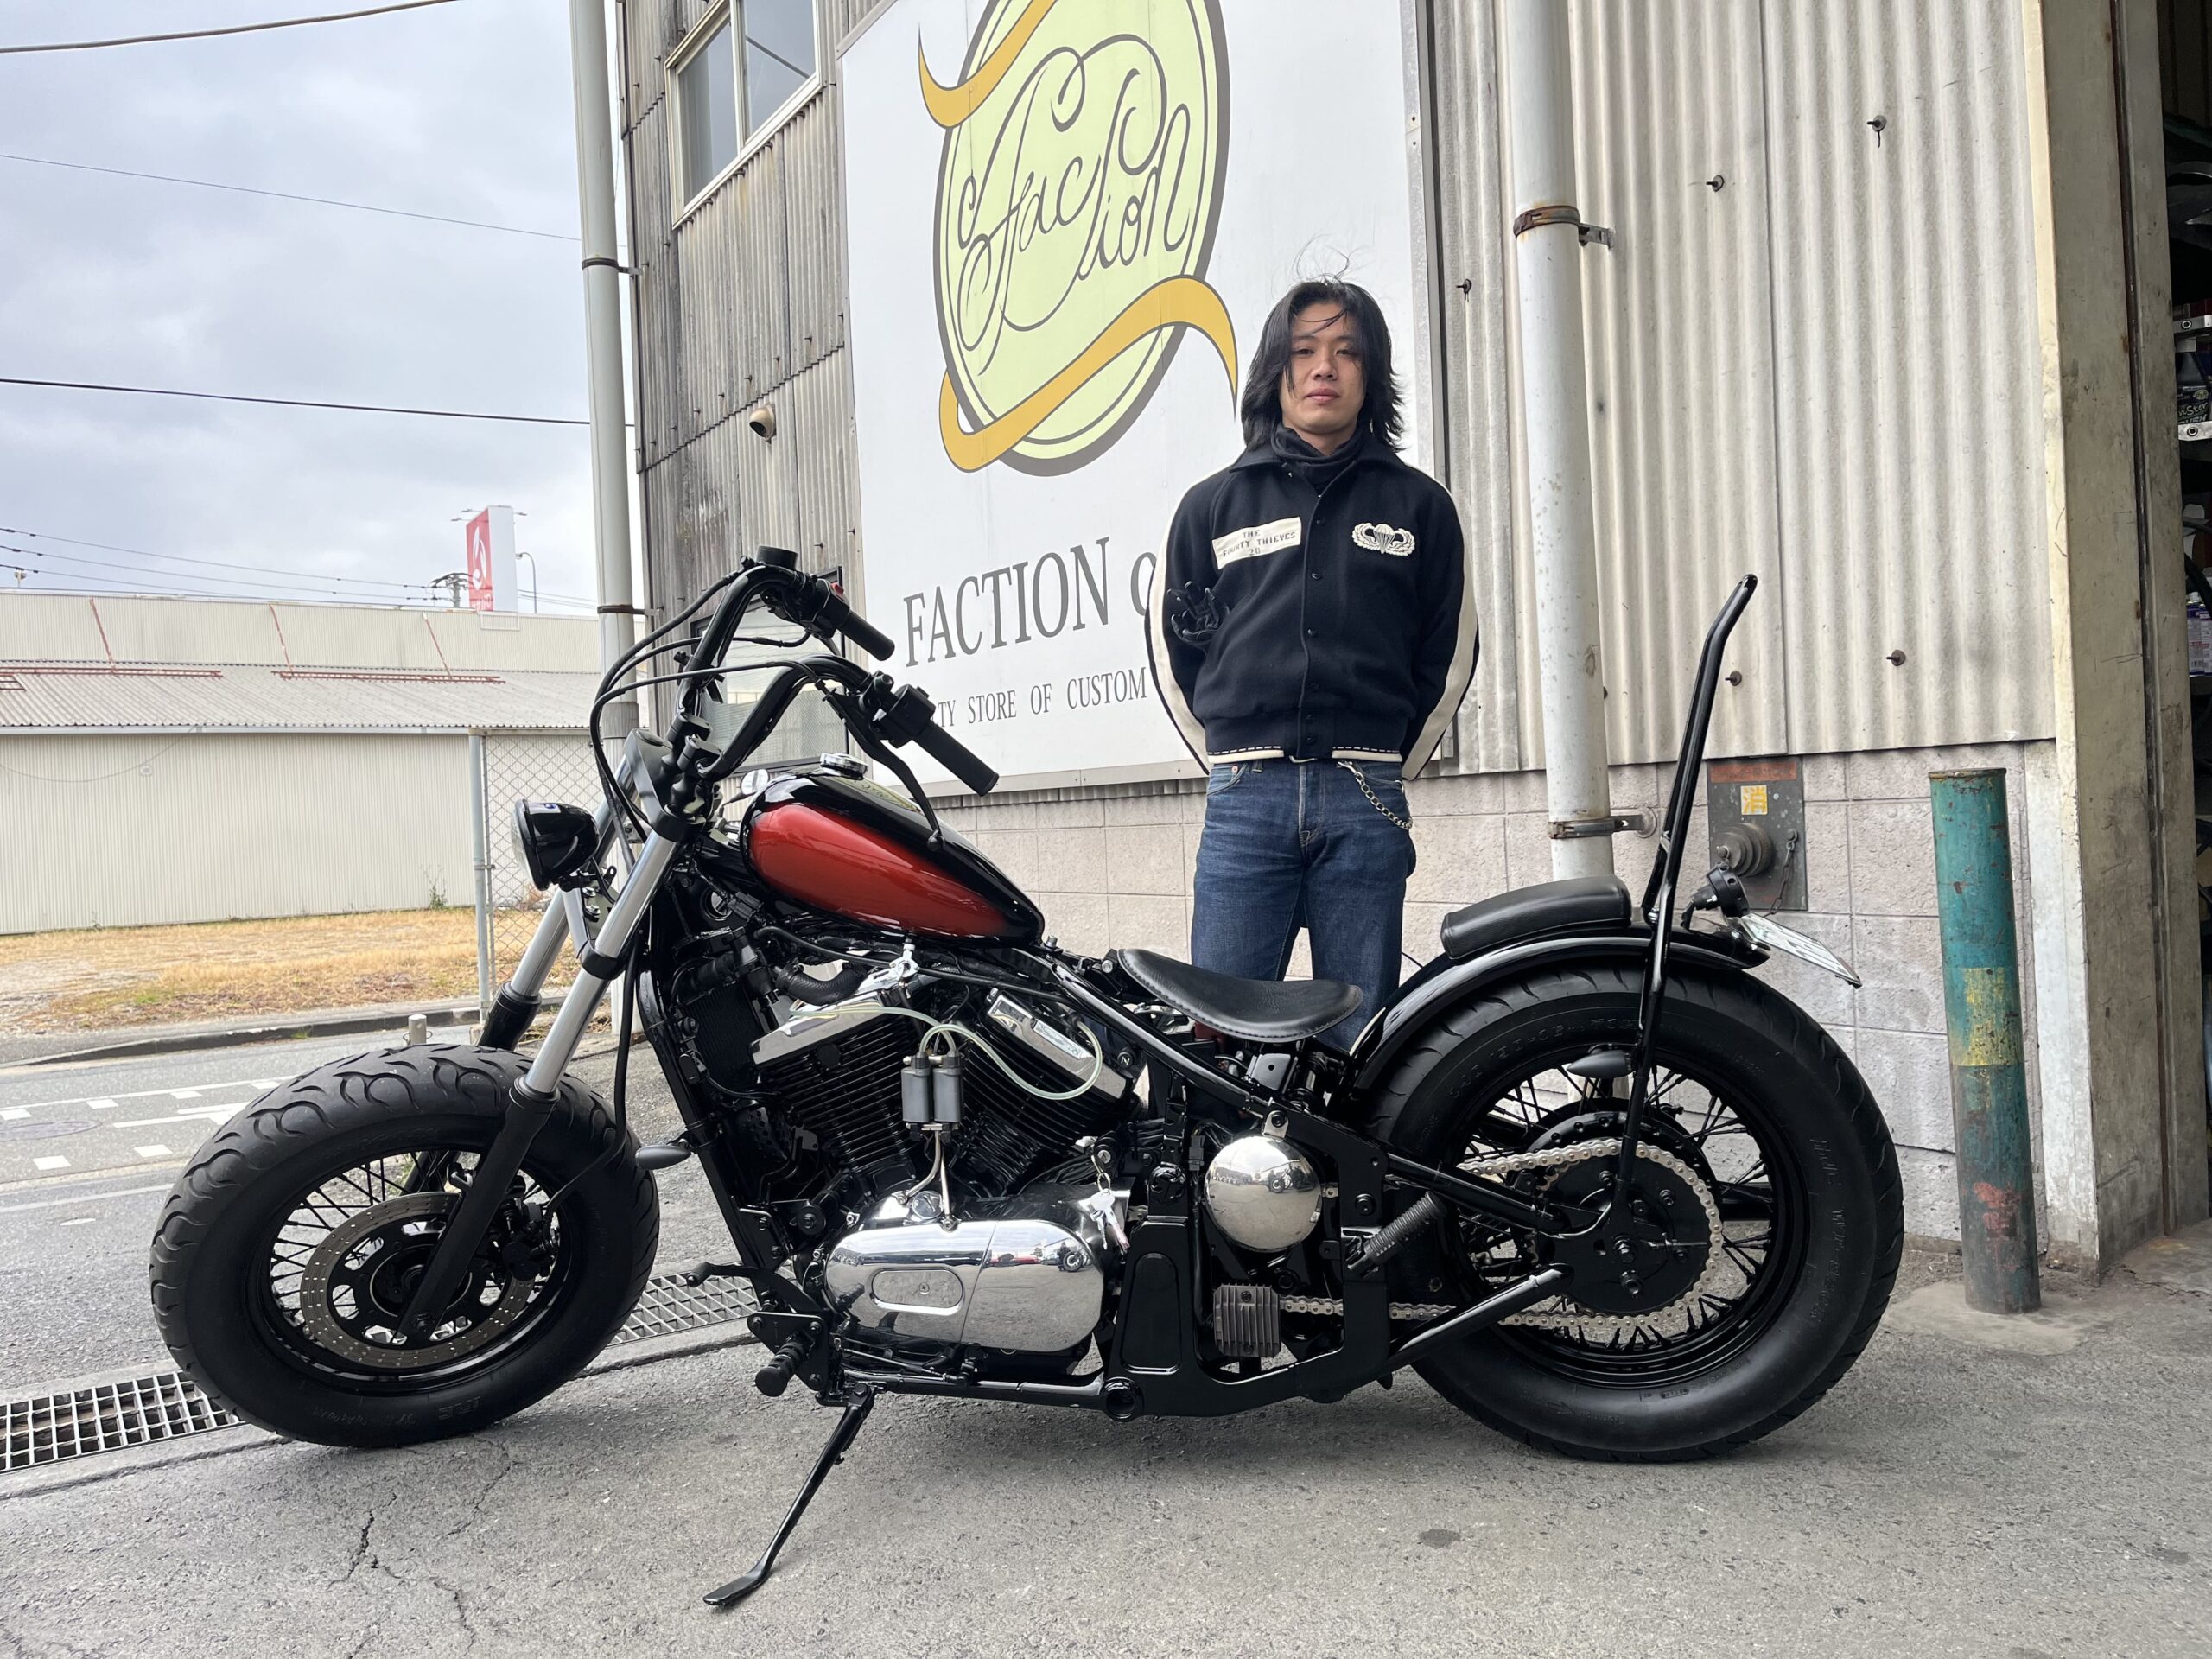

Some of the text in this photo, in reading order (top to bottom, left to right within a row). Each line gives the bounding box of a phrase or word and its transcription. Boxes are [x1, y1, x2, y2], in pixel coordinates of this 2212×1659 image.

[1243, 529, 1261, 538] THE
[1257, 531, 1296, 545] THIEVES
[903, 536, 1110, 668] FACTION
[931, 667, 1147, 728] TY STORE OF CUSTOM
